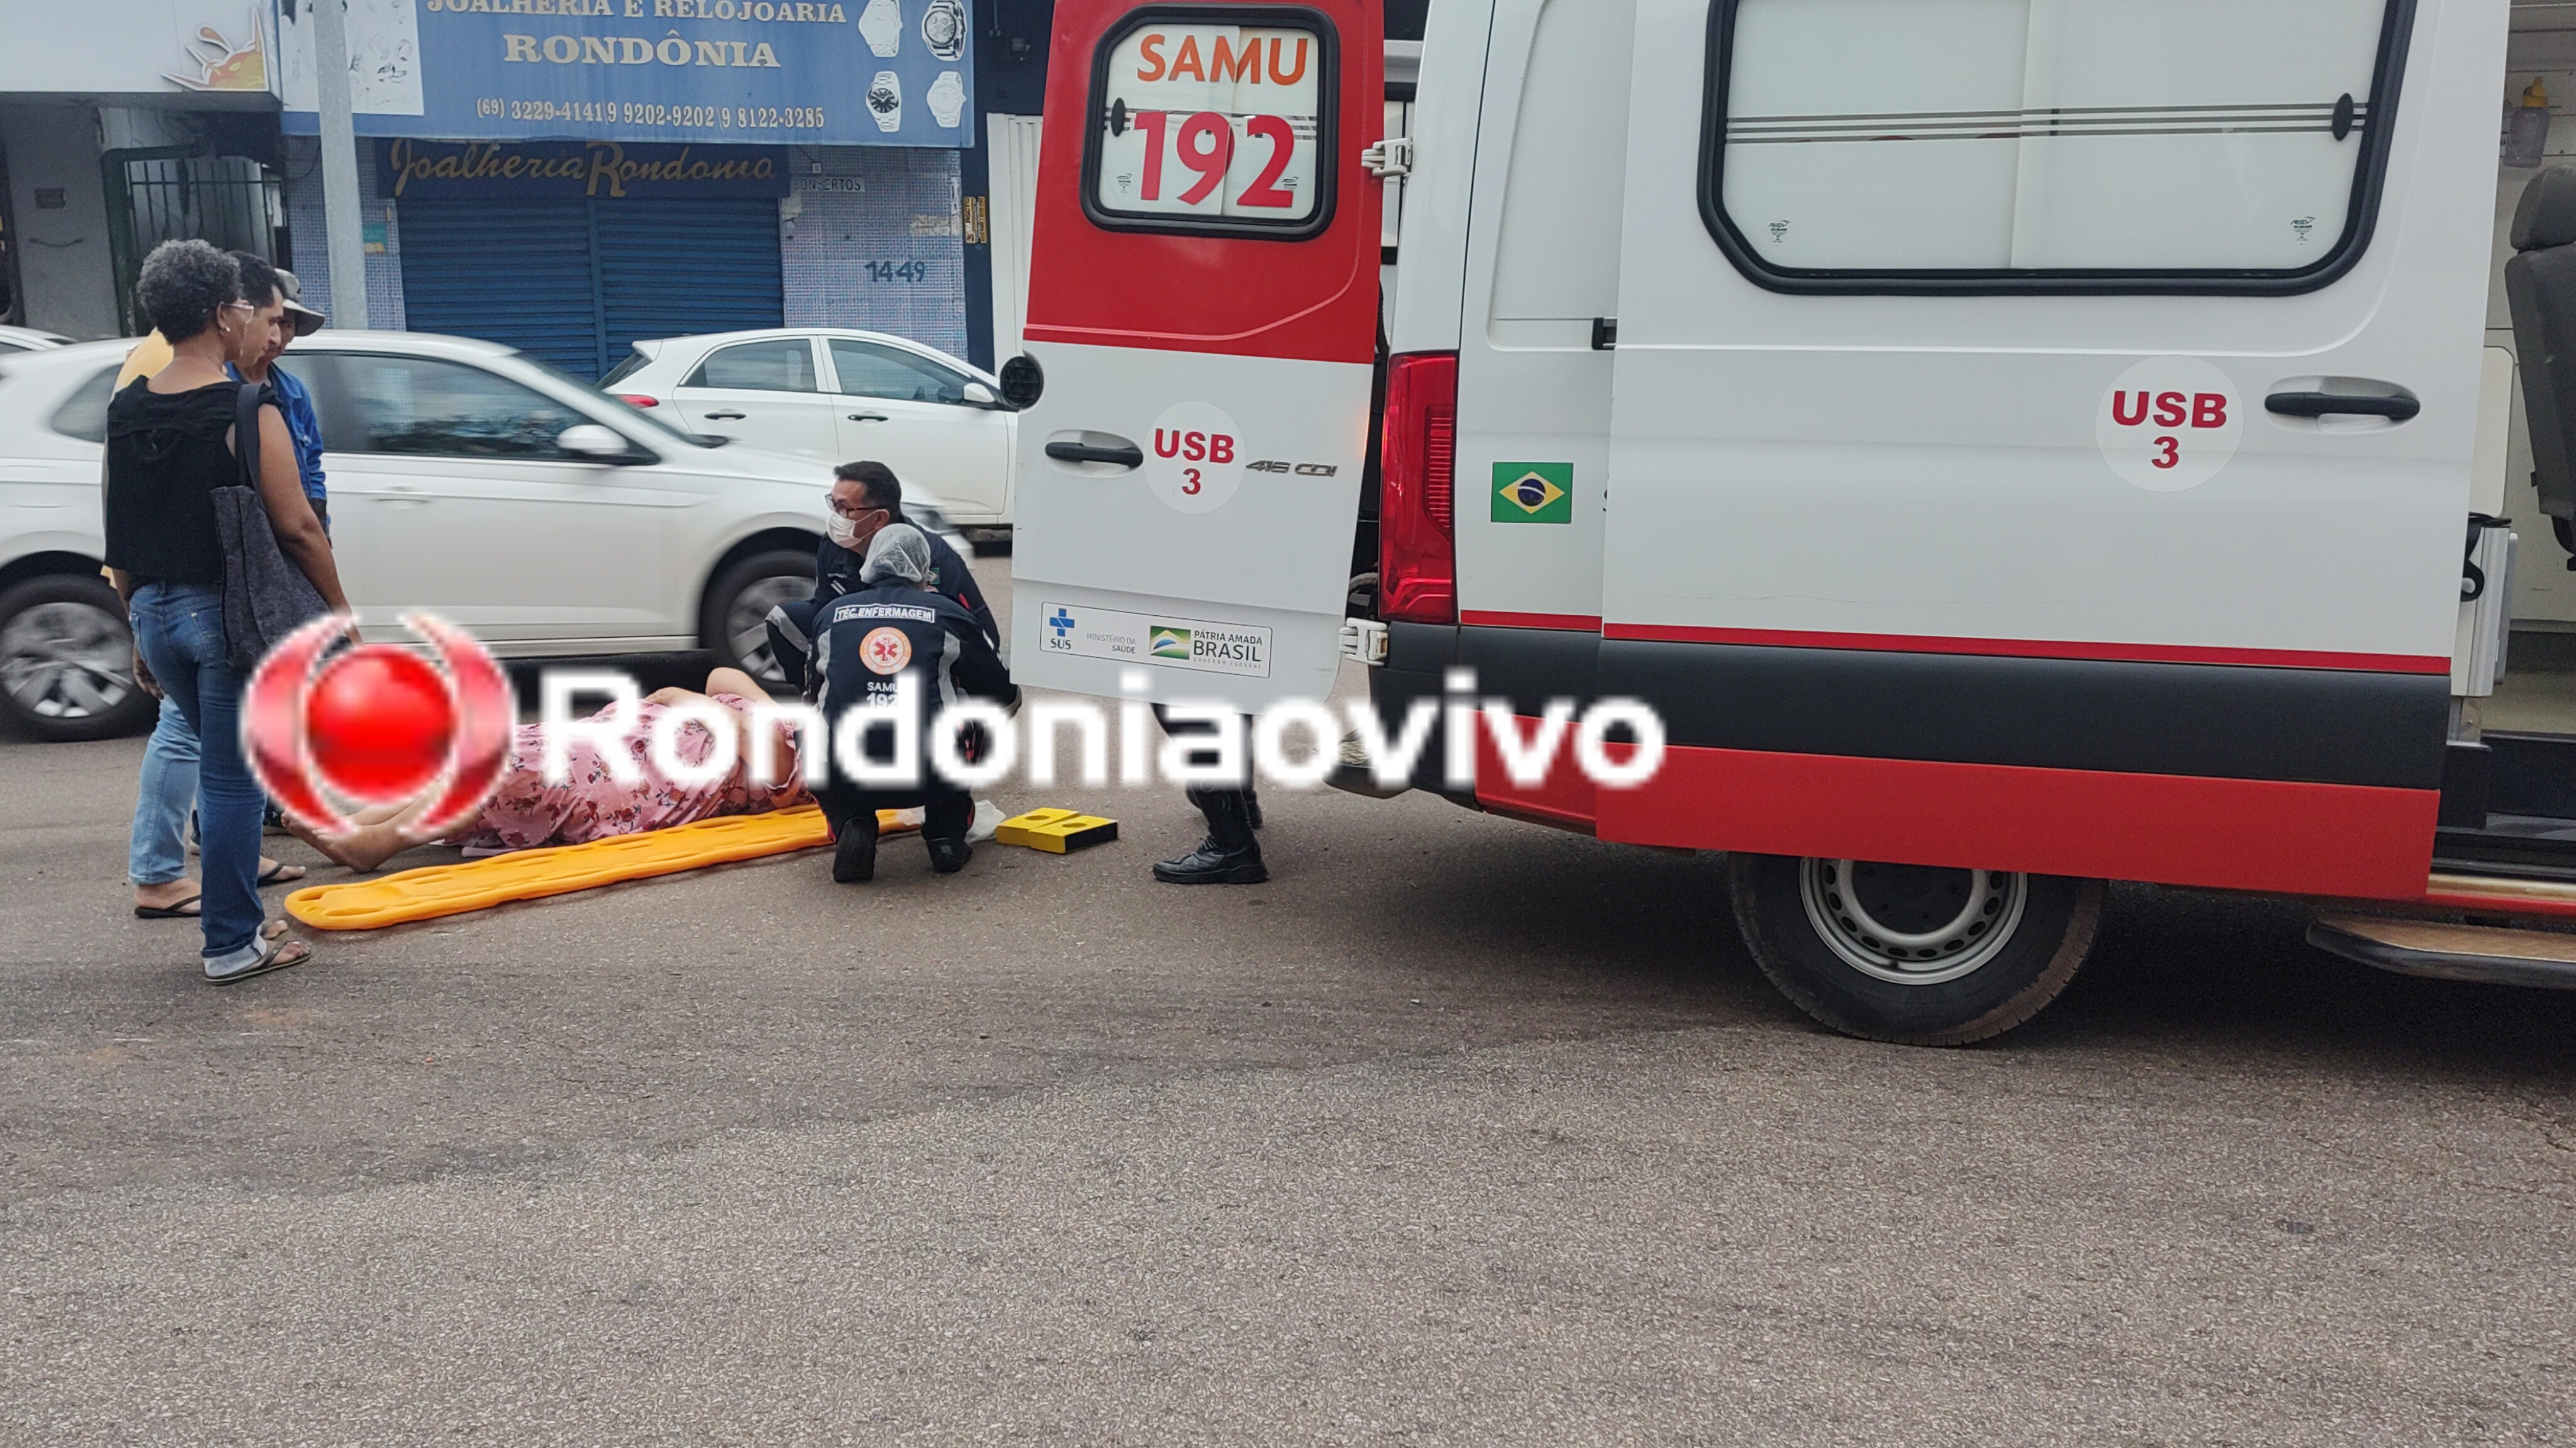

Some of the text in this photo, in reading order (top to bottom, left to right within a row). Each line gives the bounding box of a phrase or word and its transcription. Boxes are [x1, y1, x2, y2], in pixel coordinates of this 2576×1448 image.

[426, 0, 847, 23] JOALHERIA E RELOJOARIA
[503, 29, 782, 67] RONDÔNIA
[1137, 33, 1308, 86] SAMU
[477, 97, 504, 120] (69)
[391, 137, 586, 197] Joalheria
[1134, 111, 1295, 208] 192
[864, 260, 925, 282] 1449
[2112, 391, 2227, 428] USB
[1154, 428, 1235, 464] USB
[2151, 436, 2179, 469] 3
[1181, 468, 1201, 495] 3
[1294, 463, 1338, 477] CDI
[1050, 638, 1071, 650] SUS
[1086, 632, 1136, 645] MINISTÉRIO DA
[1111, 643, 1136, 654] SAÚDE
[1194, 629, 1263, 646] PÁTRIA AMADA
[1194, 640, 1262, 662] BRASIL
